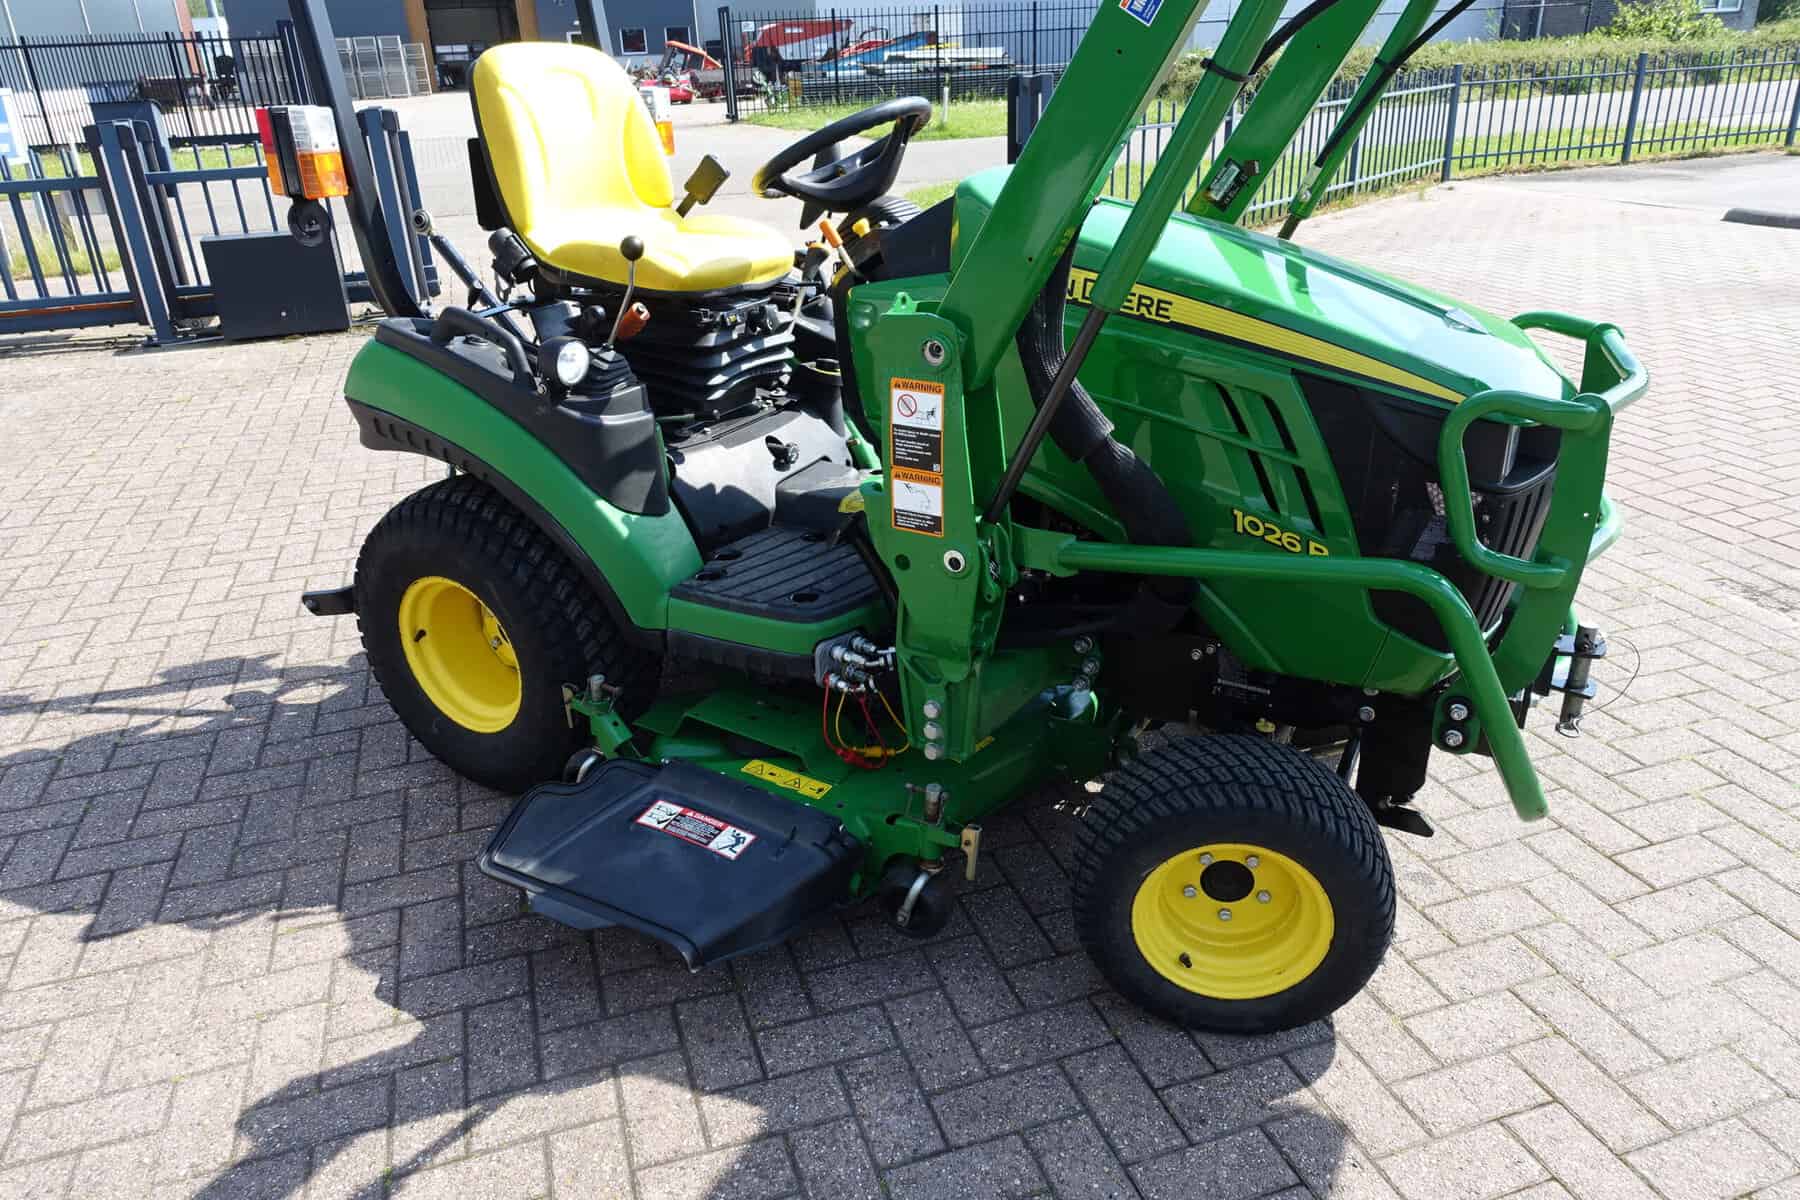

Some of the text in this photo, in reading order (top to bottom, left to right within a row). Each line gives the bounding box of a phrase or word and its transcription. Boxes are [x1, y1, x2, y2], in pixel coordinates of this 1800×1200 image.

[1081, 278, 1174, 319] DERE
[901, 380, 942, 394] WARNING
[901, 471, 941, 485] WARNING
[1233, 508, 1302, 553] 1026
[694, 812, 723, 828] DANGER
